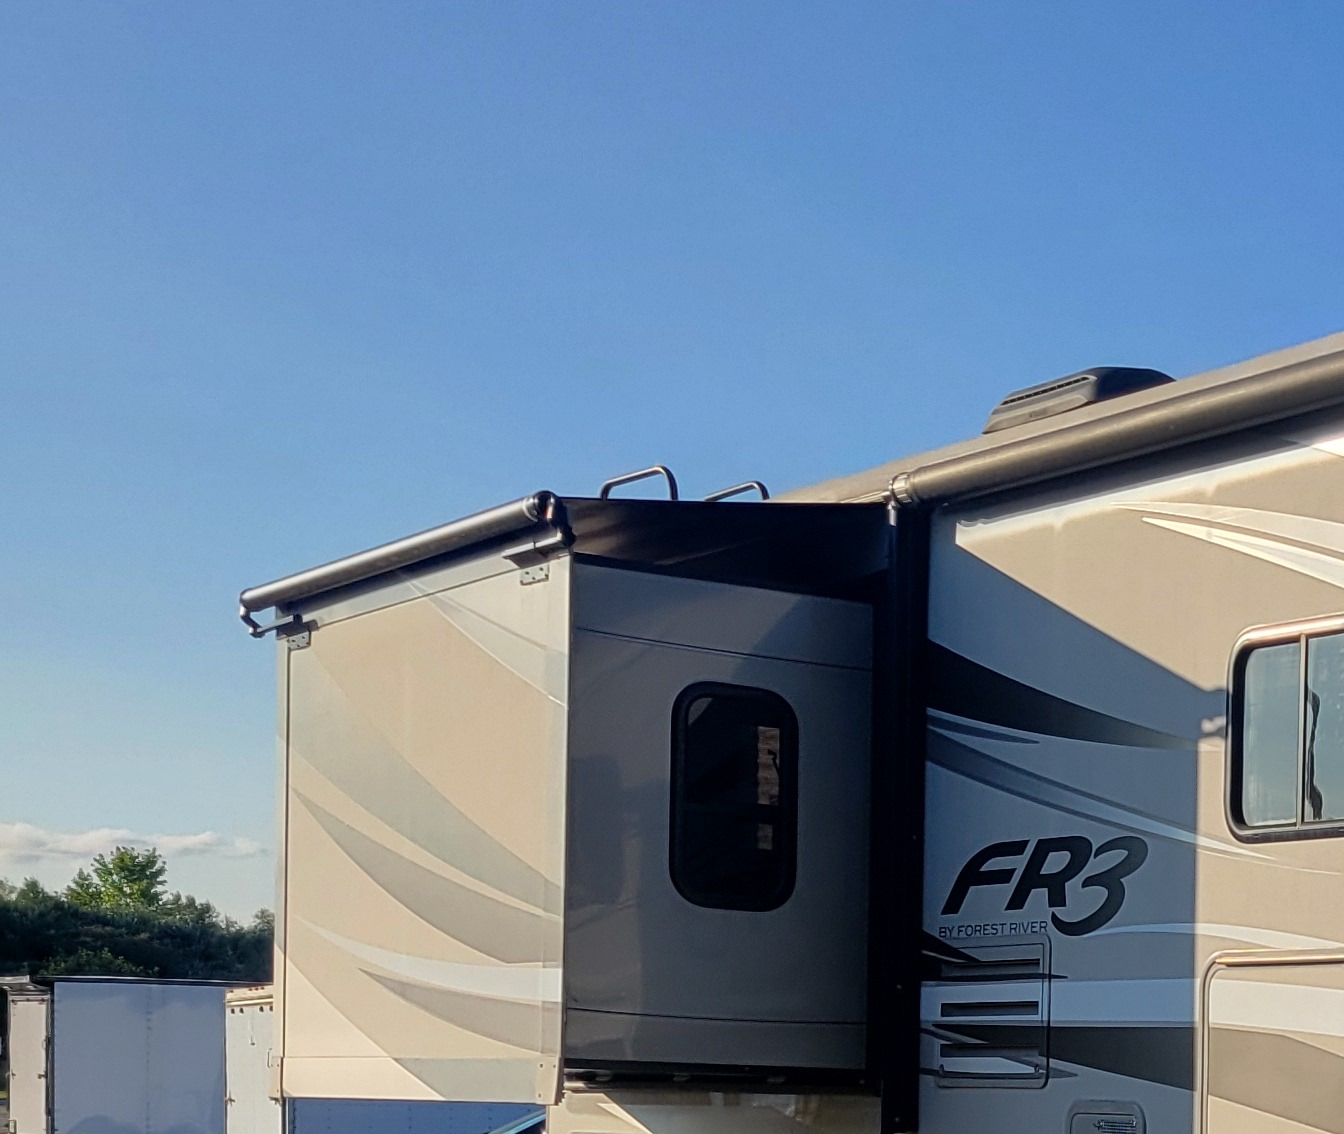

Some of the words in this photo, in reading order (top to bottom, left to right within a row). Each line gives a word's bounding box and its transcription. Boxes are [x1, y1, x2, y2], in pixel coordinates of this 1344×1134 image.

[941, 835, 1149, 937] FR3
[938, 925, 955, 938] BY
[957, 923, 1005, 937] FOREST
[1009, 920, 1048, 935] RIVER
